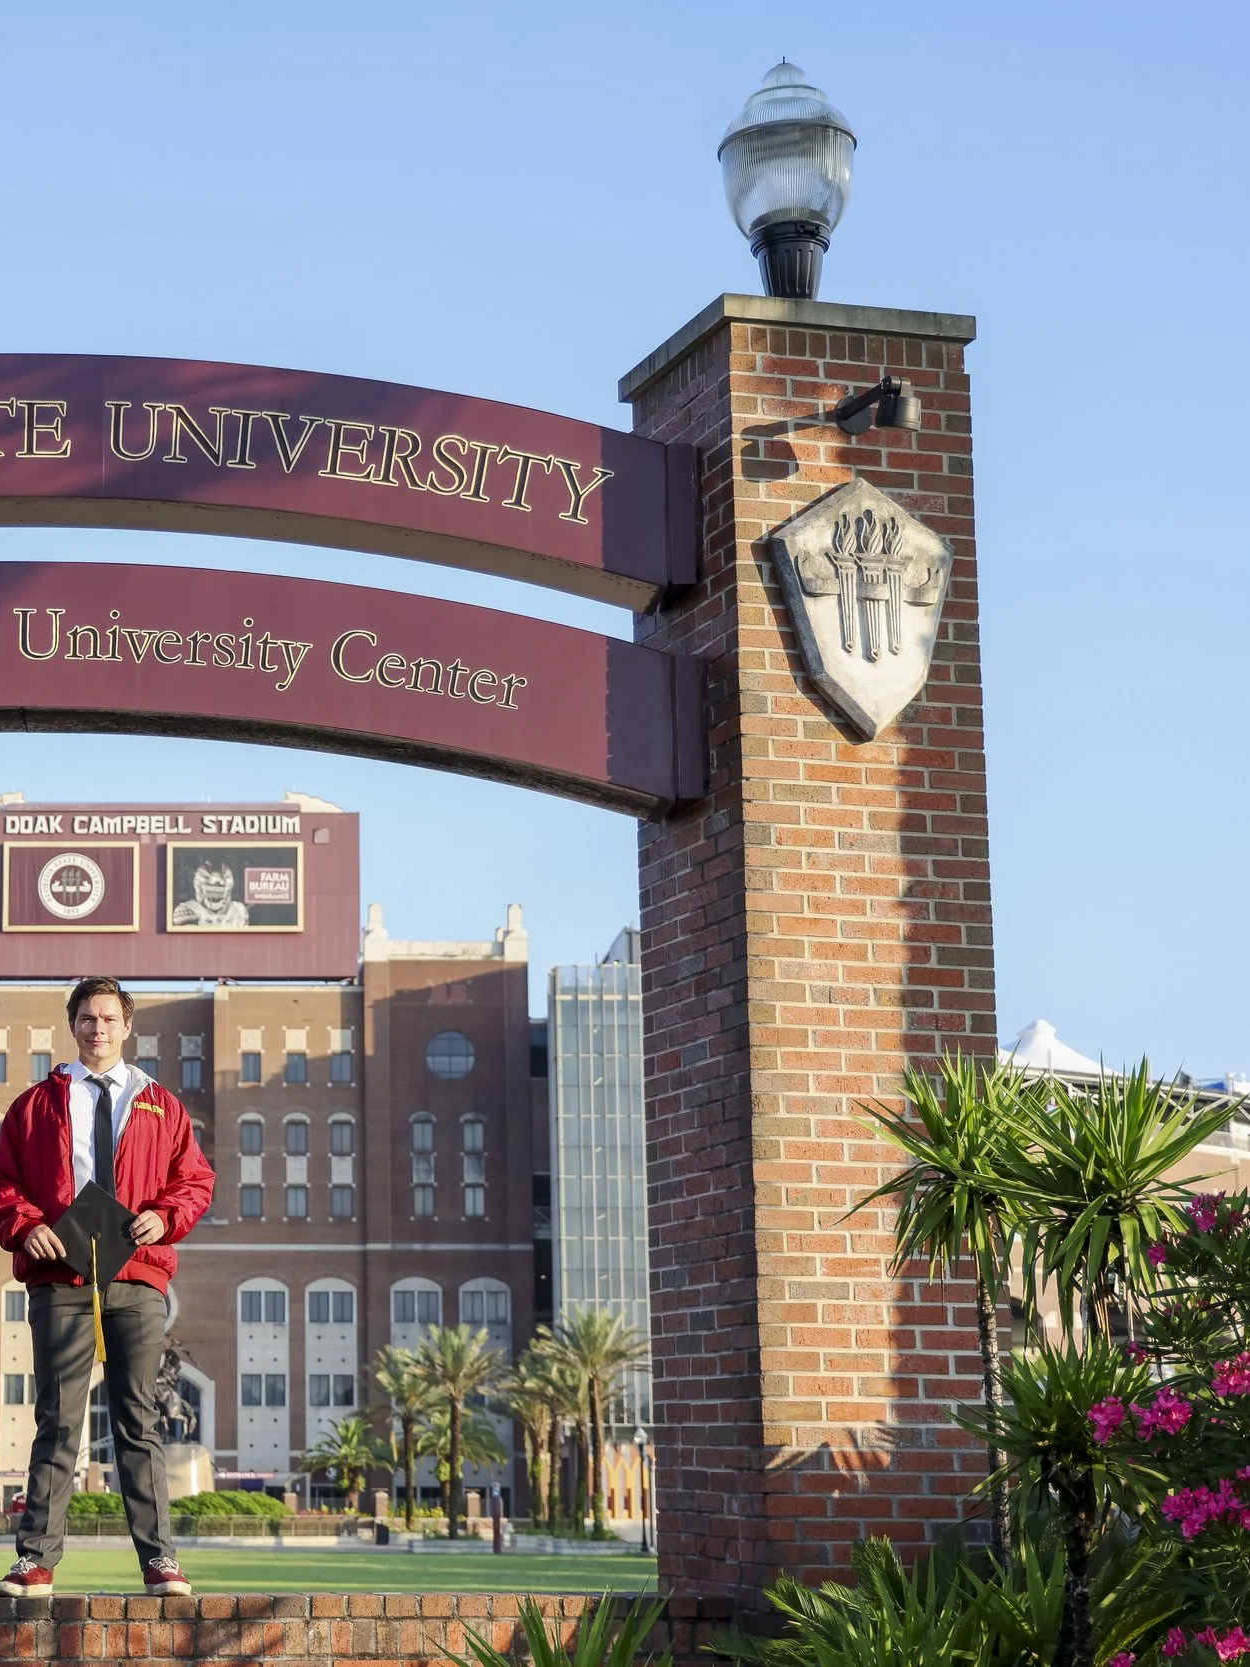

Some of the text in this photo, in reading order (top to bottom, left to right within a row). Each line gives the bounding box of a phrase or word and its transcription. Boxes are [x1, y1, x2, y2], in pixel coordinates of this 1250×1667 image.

[105, 400, 614, 525] UNIVERSITY
[13, 608, 313, 691] University
[330, 629, 528, 710] Center
[5, 815, 301, 834] DOAK CAMPBELL STADIUM
[53, 857, 76, 868] STATE
[260, 872, 290, 881] FARM
[249, 881, 290, 891] BUREAU
